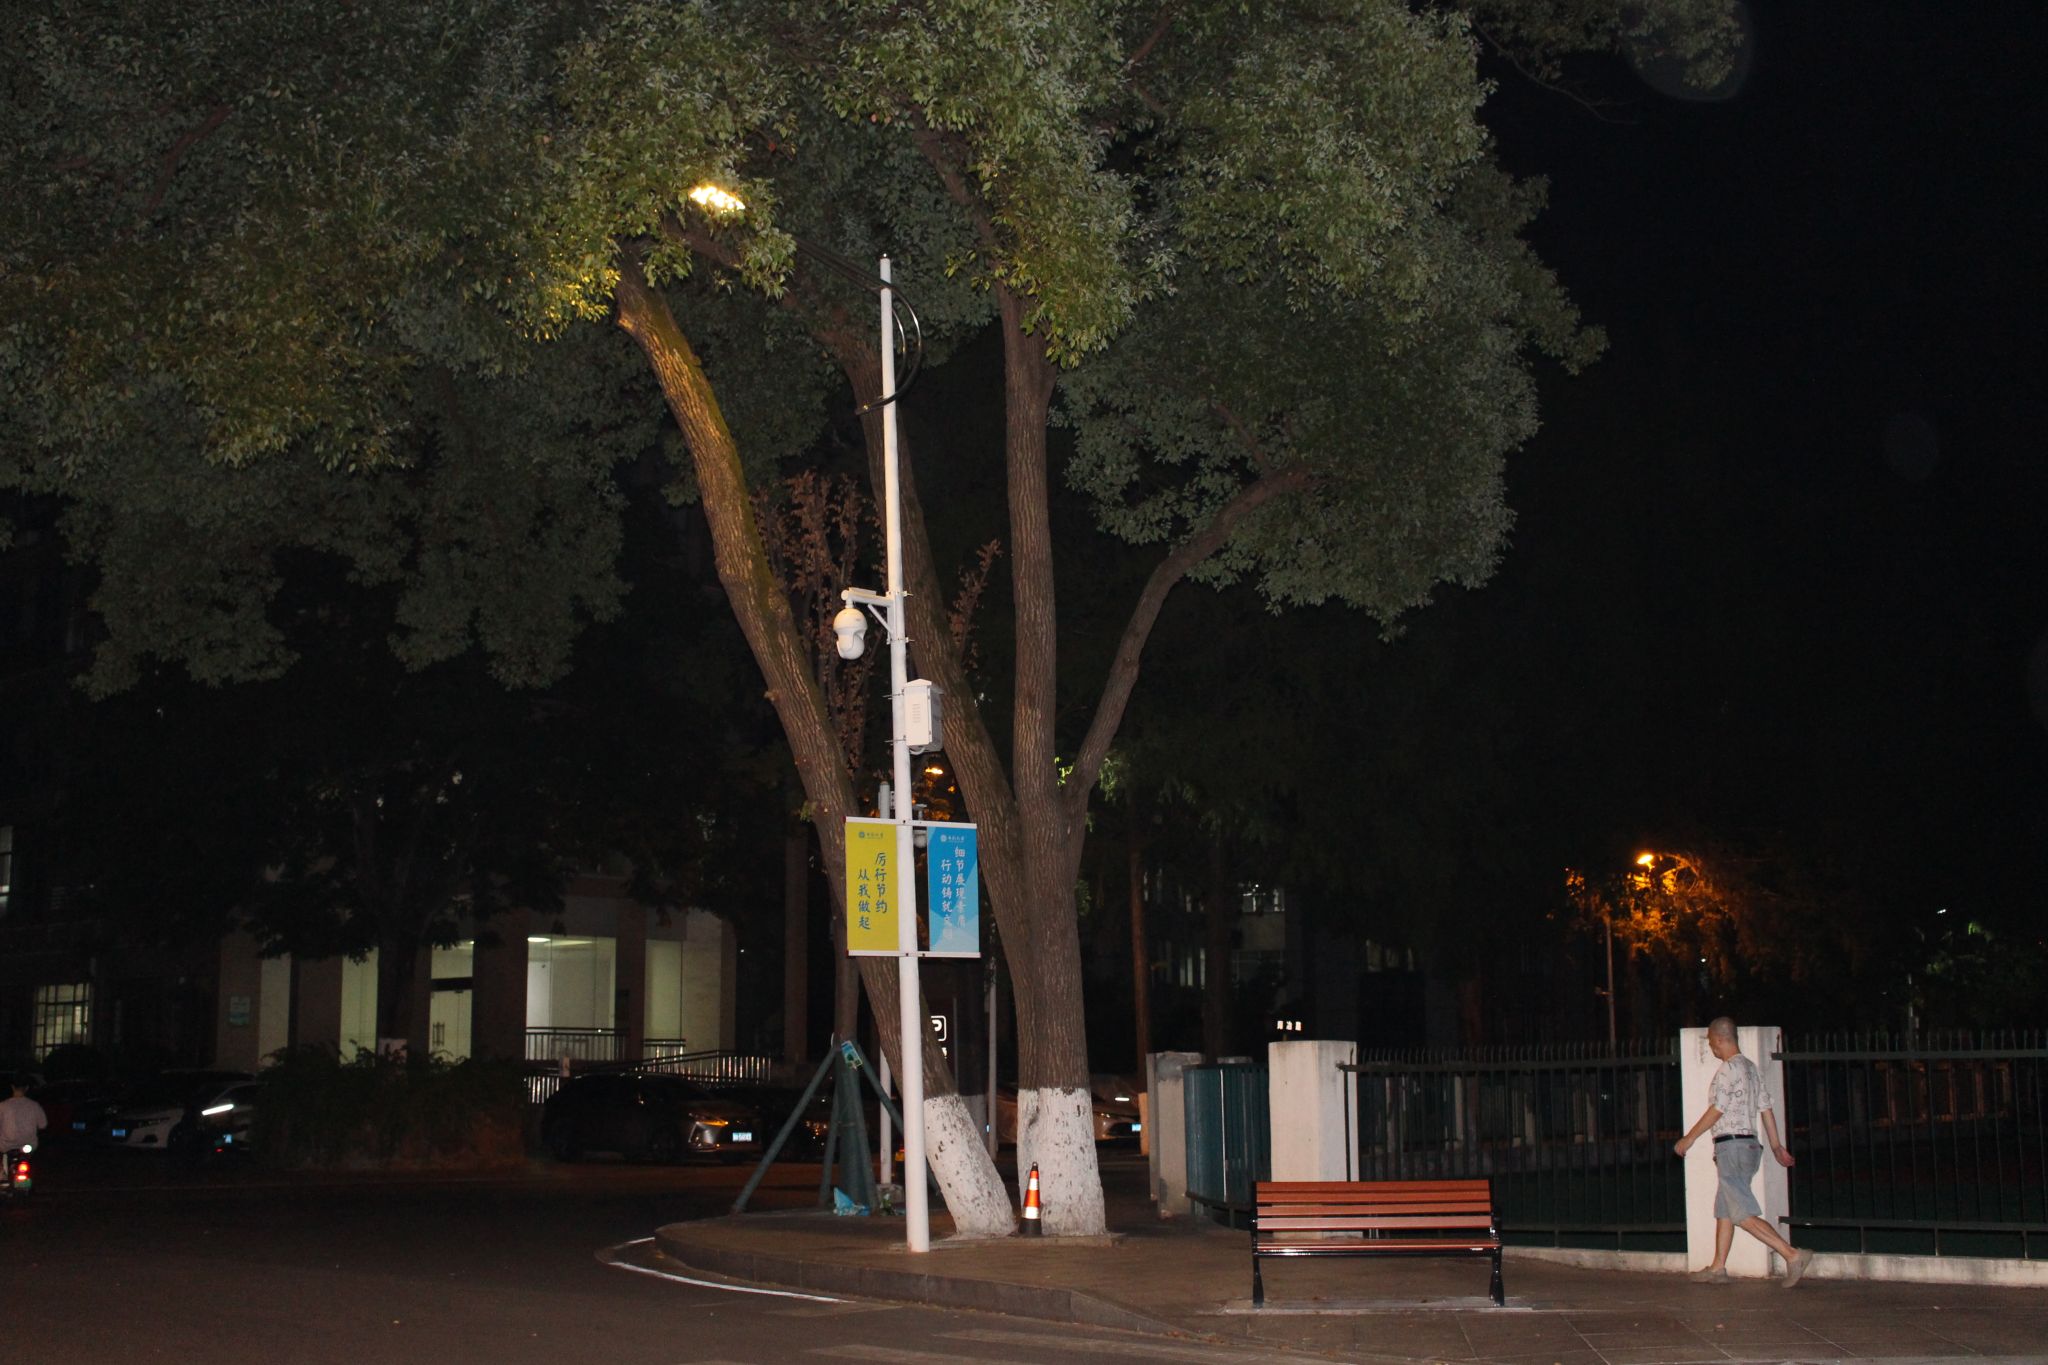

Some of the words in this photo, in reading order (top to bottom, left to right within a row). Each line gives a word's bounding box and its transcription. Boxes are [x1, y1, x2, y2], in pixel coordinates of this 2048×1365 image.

[858, 868, 871, 930] 从我做起
[875, 852, 888, 914] 厉行节约
[941, 858, 953, 939] 行动铸就文
